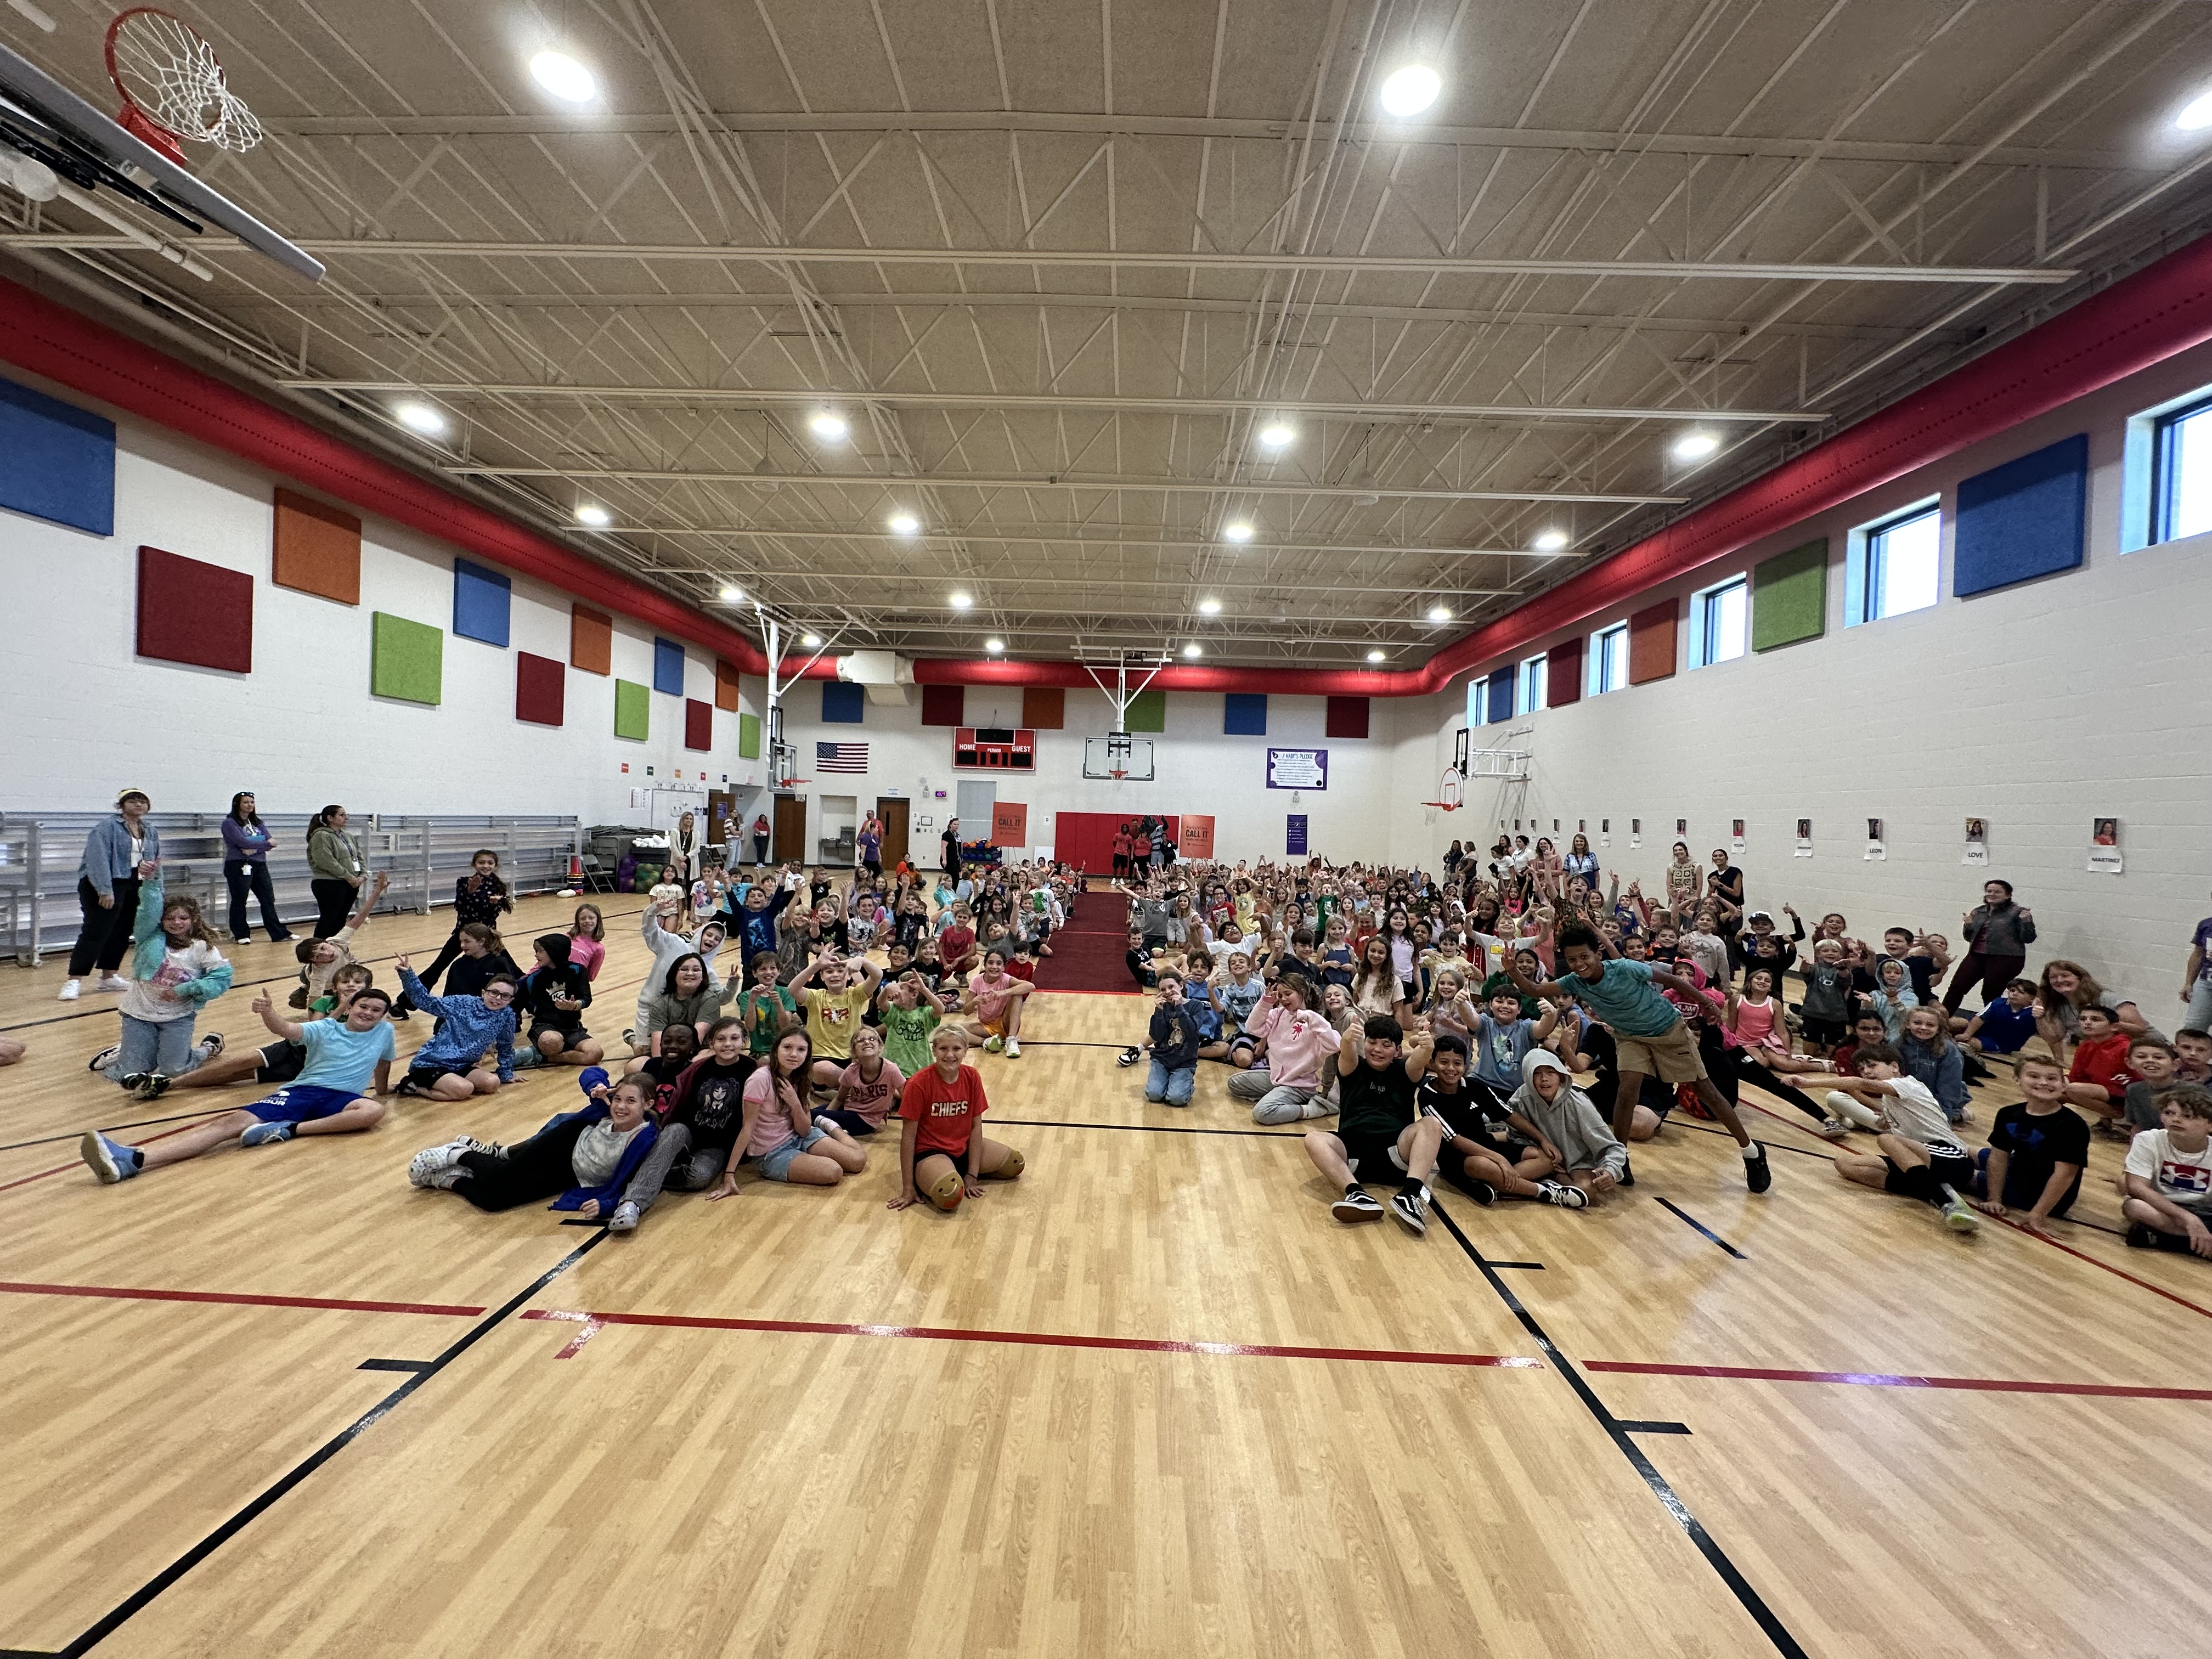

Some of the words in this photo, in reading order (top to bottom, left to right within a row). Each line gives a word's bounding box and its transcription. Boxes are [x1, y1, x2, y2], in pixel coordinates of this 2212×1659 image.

[998, 818, 1013, 826] CALL
[1186, 830, 1200, 838] CALL
[931, 1101, 968, 1117] CHIEFS
